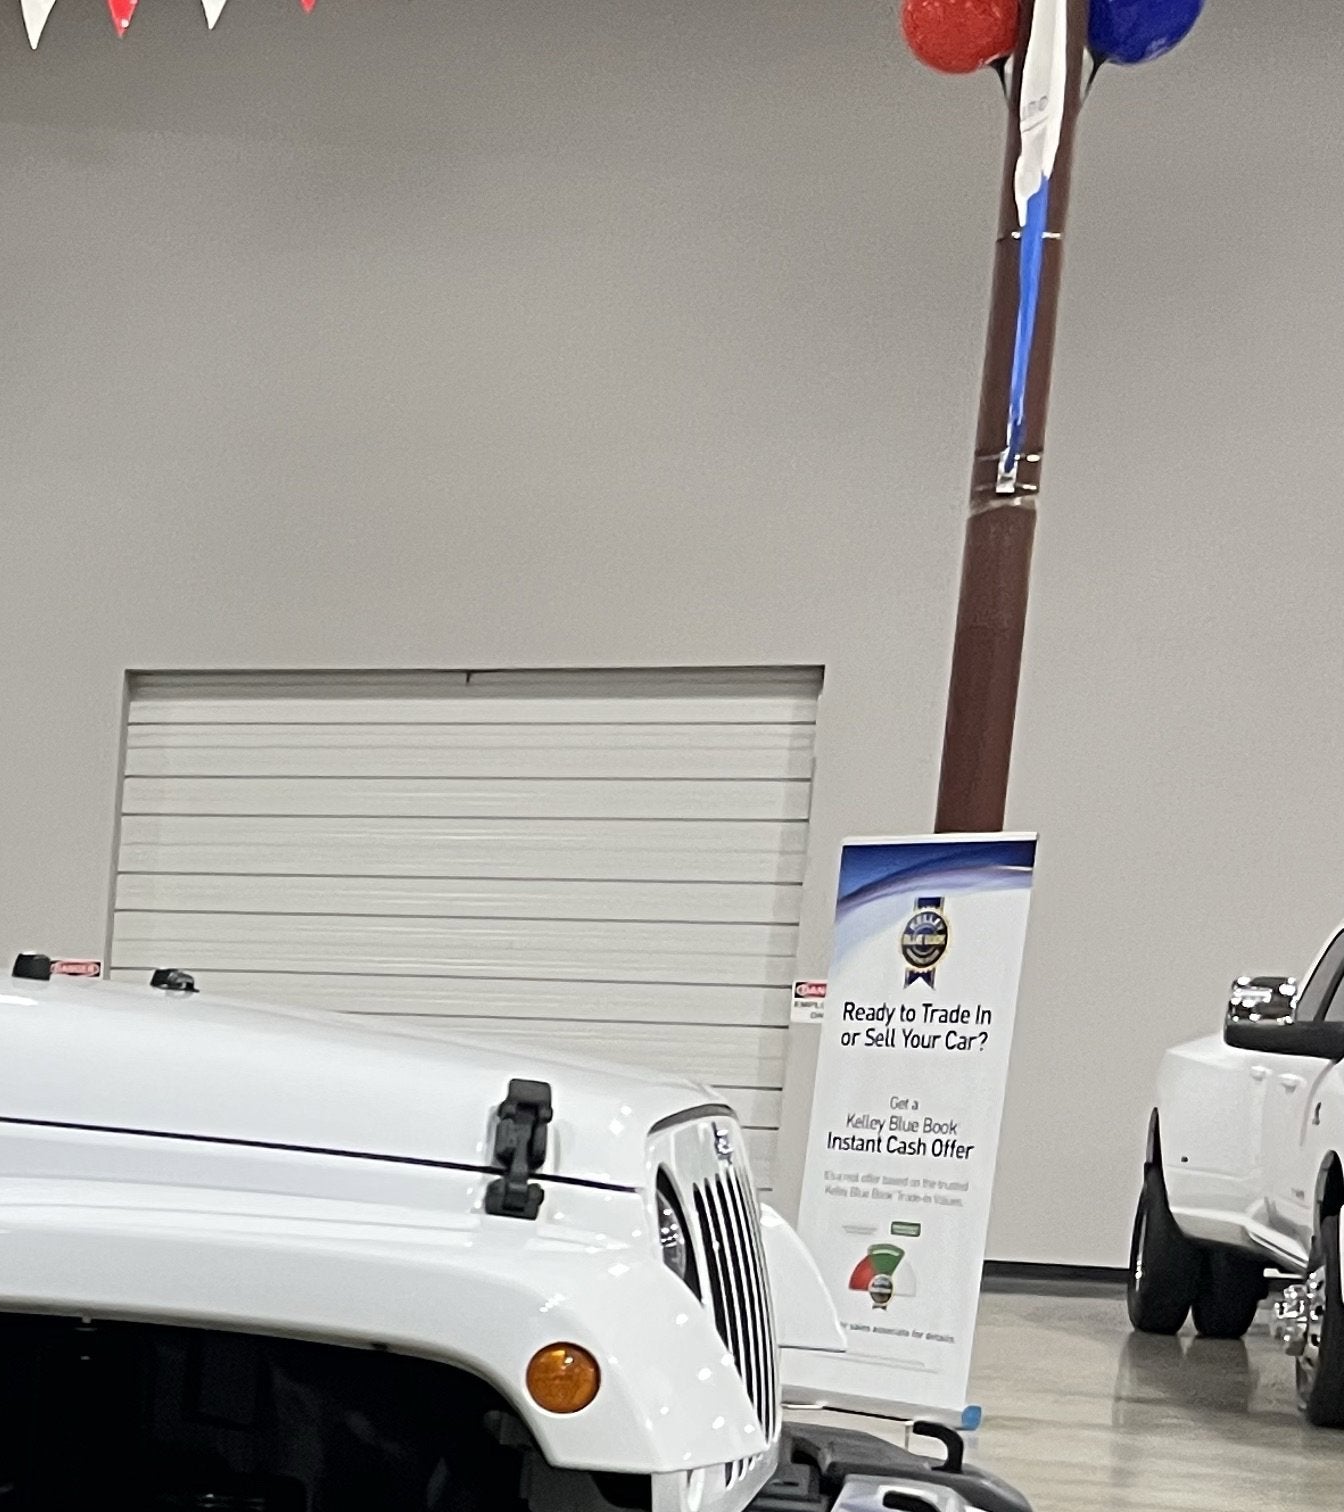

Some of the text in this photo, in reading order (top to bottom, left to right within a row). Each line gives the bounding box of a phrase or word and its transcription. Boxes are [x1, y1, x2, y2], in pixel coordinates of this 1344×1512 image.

[843, 1001, 992, 1026] Ready to Trade In
[840, 1028, 989, 1052] or Sell Your Car?
[889, 1096, 919, 1110] Get a
[846, 1112, 958, 1135] Kelley Blue Book
[827, 1132, 975, 1160] Instant Cash Offer
